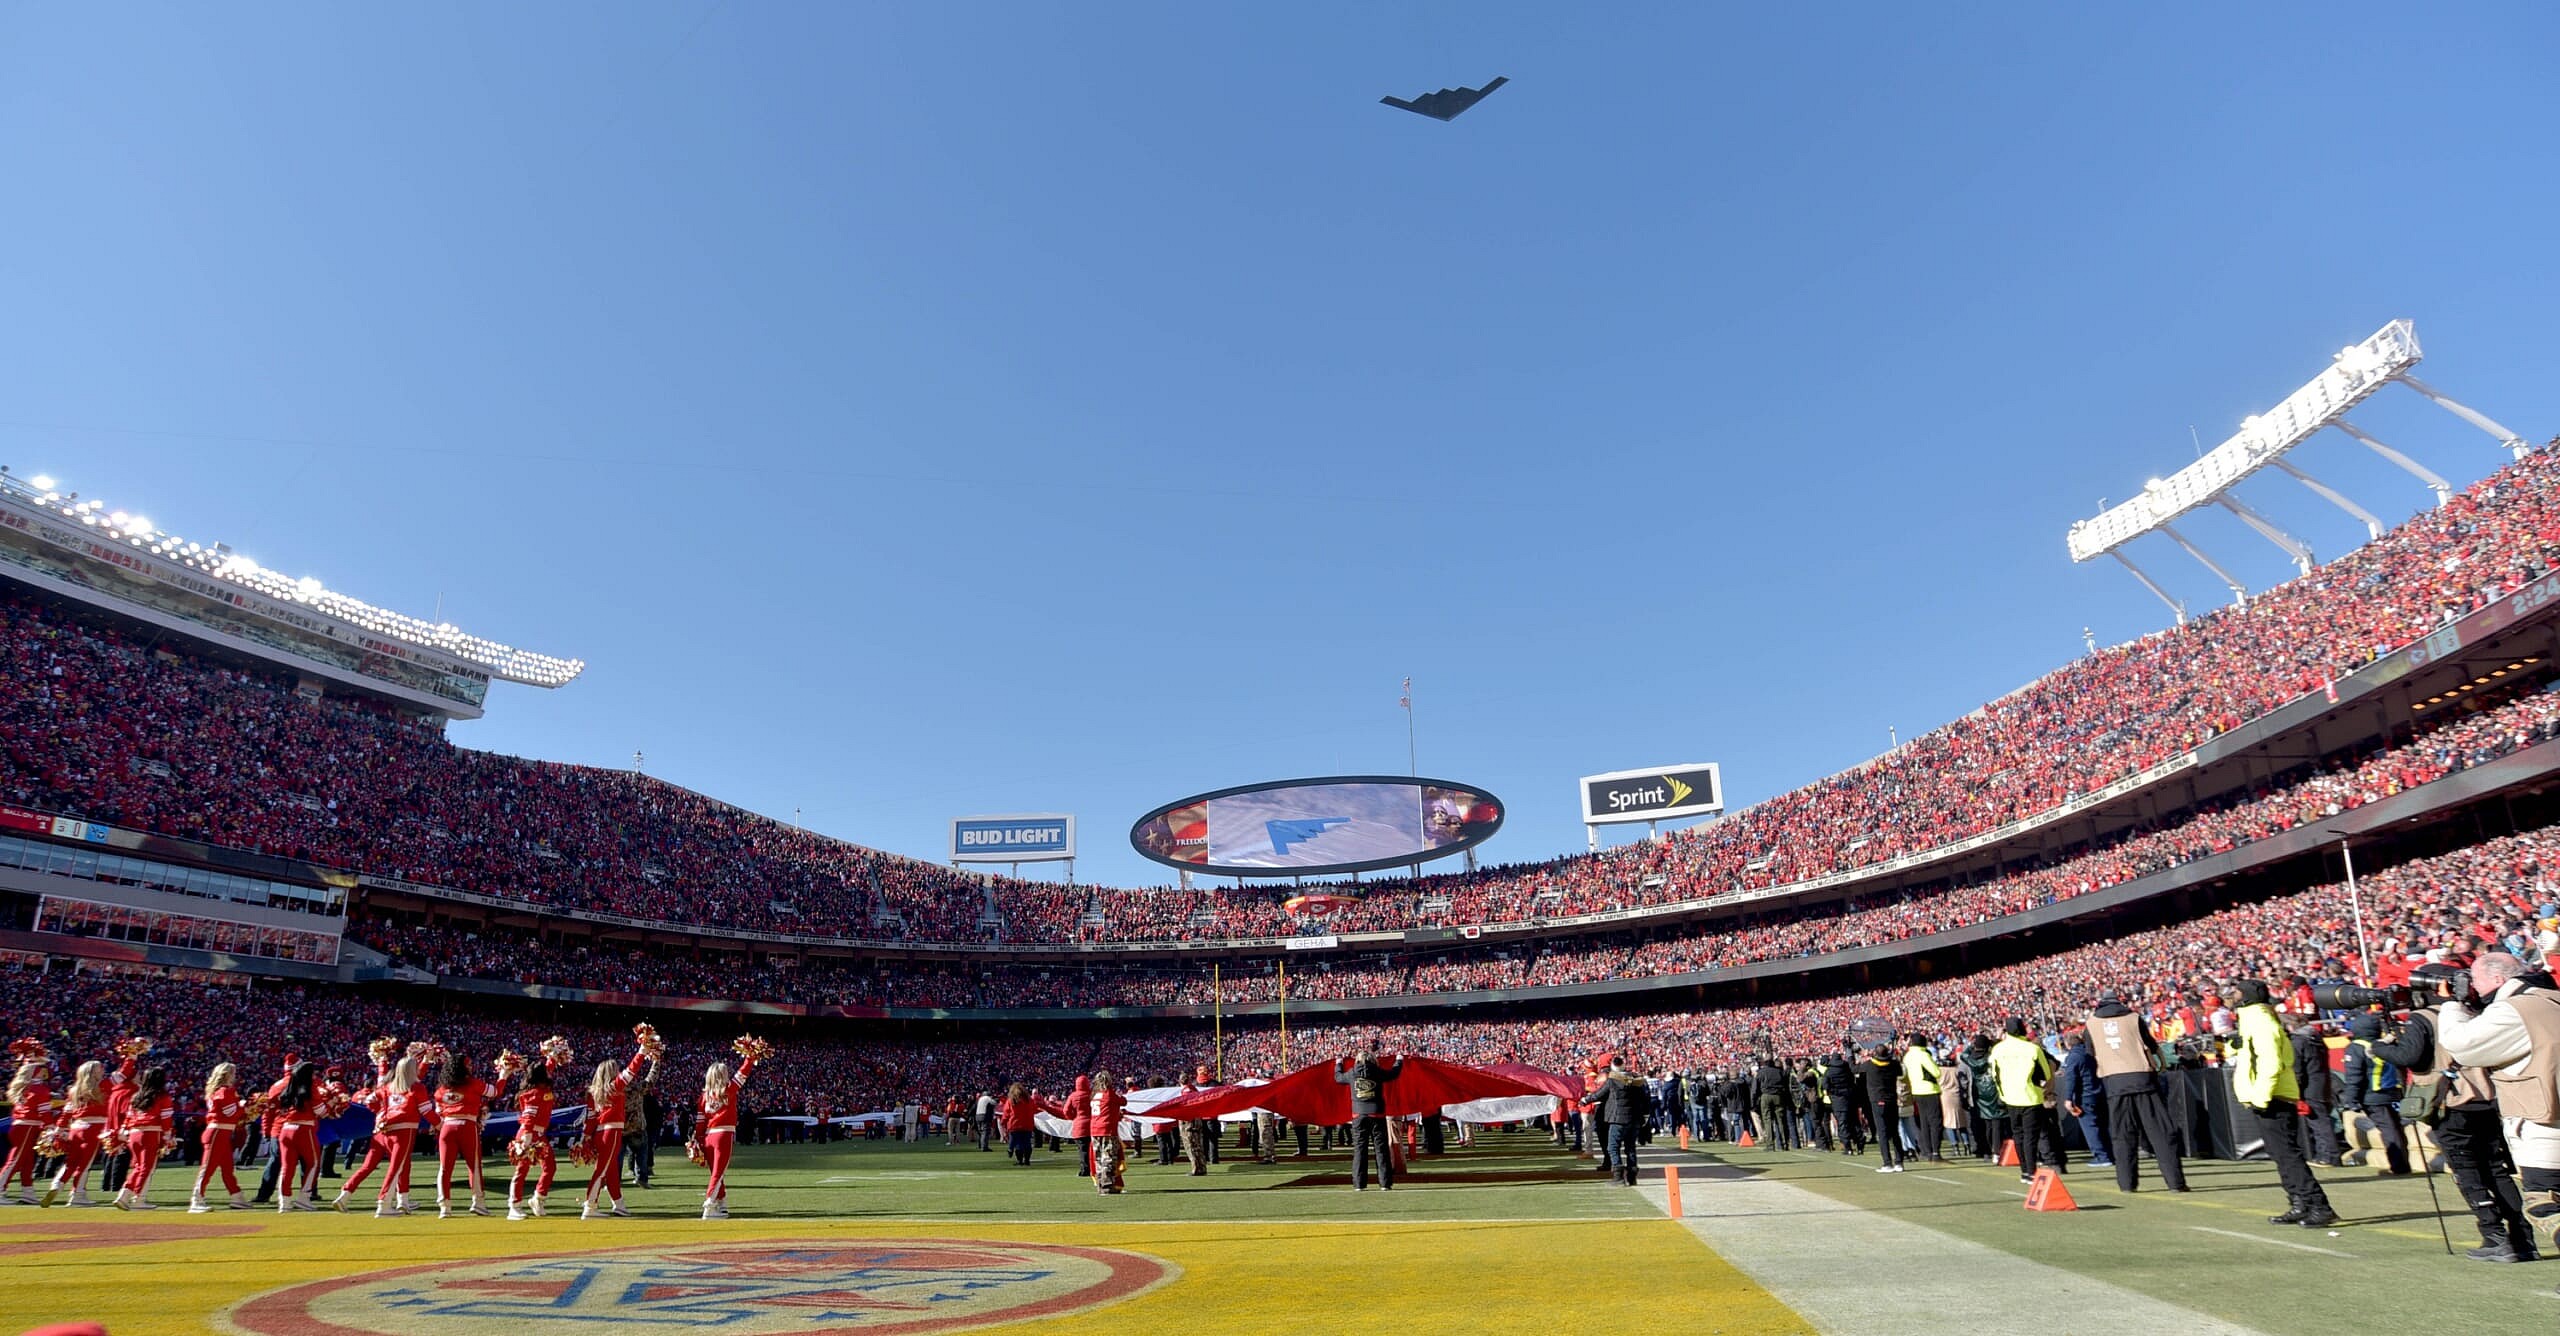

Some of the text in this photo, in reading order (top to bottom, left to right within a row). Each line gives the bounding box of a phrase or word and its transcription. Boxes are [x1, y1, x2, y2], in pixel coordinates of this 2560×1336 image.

[2511, 577, 2560, 616] 2:24
[1608, 786, 1665, 811] Sprint
[962, 828, 1061, 845] BUD LIGHT
[369, 878, 420, 892] LAMAR HUNT
[1294, 939, 1327, 949] GEHA
